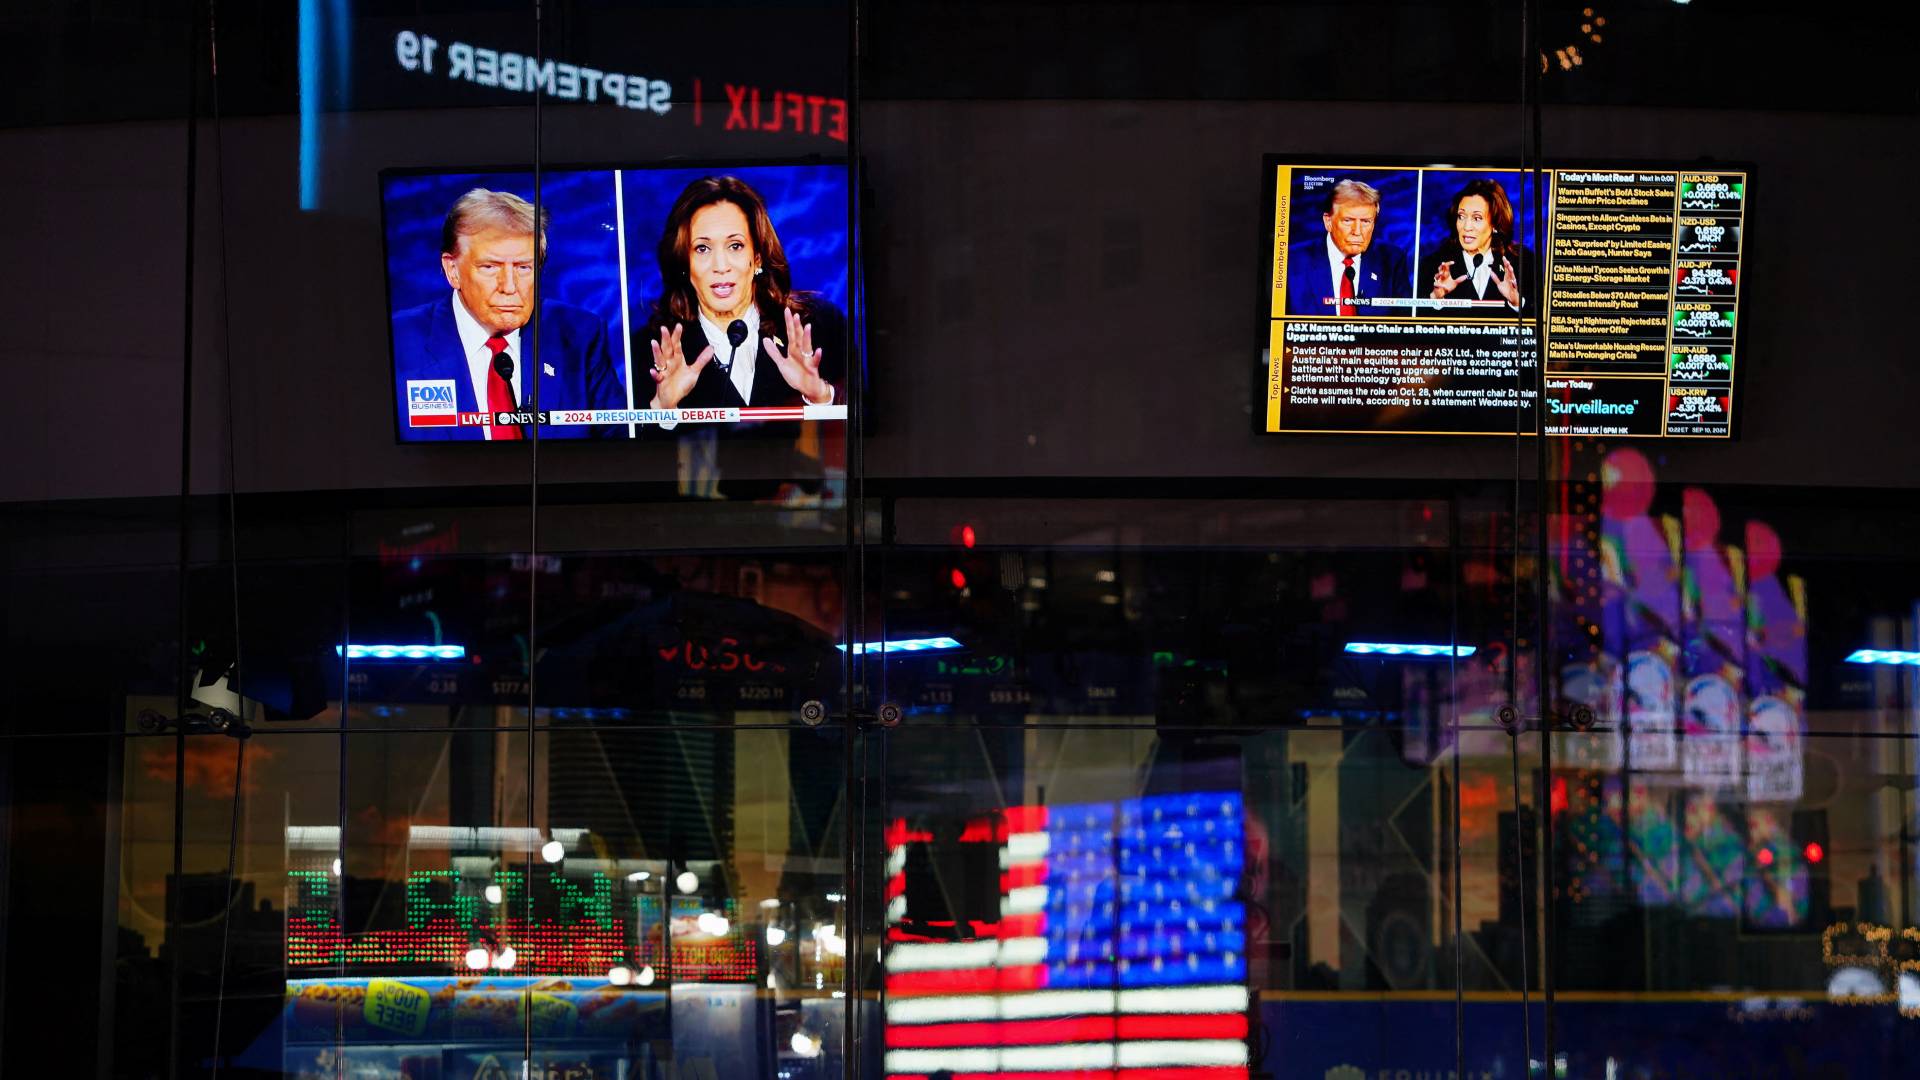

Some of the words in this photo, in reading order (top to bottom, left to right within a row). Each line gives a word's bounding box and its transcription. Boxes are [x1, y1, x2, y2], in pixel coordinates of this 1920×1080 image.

[1560, 173, 1591, 182] Today's
[1592, 173, 1612, 182] Most
[1613, 173, 1634, 182] Read
[1585, 188, 1614, 196] Buffett's
[1655, 189, 1674, 197] Sales
[1278, 196, 1286, 237] Television
[1556, 213, 1591, 223] Singapore
[1600, 214, 1618, 222] Allow
[1620, 215, 1649, 223] Cashless
[1556, 222, 1587, 231] Casinos,
[1588, 223, 1614, 232] Except
[1615, 224, 1640, 232] Crypto
[1681, 218, 1716, 226] NZD-USD
[1556, 239, 1571, 247] RBA
[1648, 241, 1670, 250] Easing
[1577, 249, 1607, 257] Gauges,
[1634, 249, 1652, 258] Says
[1276, 241, 1286, 288] Bloomberg
[1595, 266, 1618, 275] Tycoon
[1566, 274, 1623, 283] Energy-Storage
[1562, 291, 1590, 299] Steadies
[1642, 292, 1668, 300] Demand
[1589, 300, 1620, 309] Intensify
[1676, 303, 1711, 311] AUD-NZD
[1567, 317, 1583, 325] Says
[1584, 317, 1620, 326] Rightmove
[1621, 318, 1650, 326] Rejected
[1287, 323, 1308, 332] ASX
[1310, 324, 1342, 332] Names
[1344, 324, 1375, 333] Clarke
[1376, 325, 1402, 333] Chair
[1416, 326, 1445, 334] Roche
[1447, 326, 1481, 335] Retires
[1483, 327, 1507, 335] Amid
[1574, 325, 1609, 333] Takeover
[1287, 333, 1327, 342] Upgrade
[1292, 346, 1316, 354] David
[1319, 347, 1346, 355] Clarke
[1349, 347, 1362, 355] will
[1365, 348, 1398, 356] become
[1401, 348, 1421, 356] chair
[1435, 349, 1453, 357] ASX
[1476, 349, 1489, 357] the
[1575, 342, 1613, 350] Unworkable
[1614, 343, 1640, 352] Housing
[1641, 343, 1664, 351] Rescue
[1674, 346, 1708, 354] EUR-AUD
[1576, 351, 1615, 360] Prolonging
[1292, 356, 1338, 364] Australia's
[1364, 357, 1398, 366] equities
[1420, 358, 1467, 366] derivatives
[1470, 359, 1512, 368] exchange
[1292, 365, 1322, 373] battled
[1354, 366, 1400, 375] years-long
[1403, 367, 1439, 376] upgrade
[1442, 367, 1450, 375] of
[1466, 368, 1501, 377] clearing
[1292, 374, 1338, 382] settlement
[1341, 375, 1389, 384] technology
[1392, 375, 1425, 385] system.
[1547, 380, 1568, 388] Later
[1569, 381, 1592, 390] Today
[411, 387, 453, 402] FOX
[1271, 384, 1280, 400] Top
[1291, 386, 1316, 394] Clarke
[1356, 387, 1367, 395] the
[1370, 387, 1385, 395] role
[1400, 388, 1416, 396] Oct.
[1433, 388, 1453, 396] when
[1456, 389, 1484, 397] current
[1487, 389, 1506, 397] chair
[1290, 396, 1318, 404] Roche
[1321, 396, 1334, 404] will
[1338, 396, 1363, 405] retire,
[1366, 397, 1409, 406] according
[1413, 398, 1421, 406] to
[1432, 398, 1476, 407] statement
[1547, 398, 1638, 415] "Surveillance"
[462, 414, 490, 424] LIVE
[565, 412, 592, 422] 2024
[596, 411, 677, 422] PRESIDENTIAL
[682, 410, 726, 420] DEBATE
